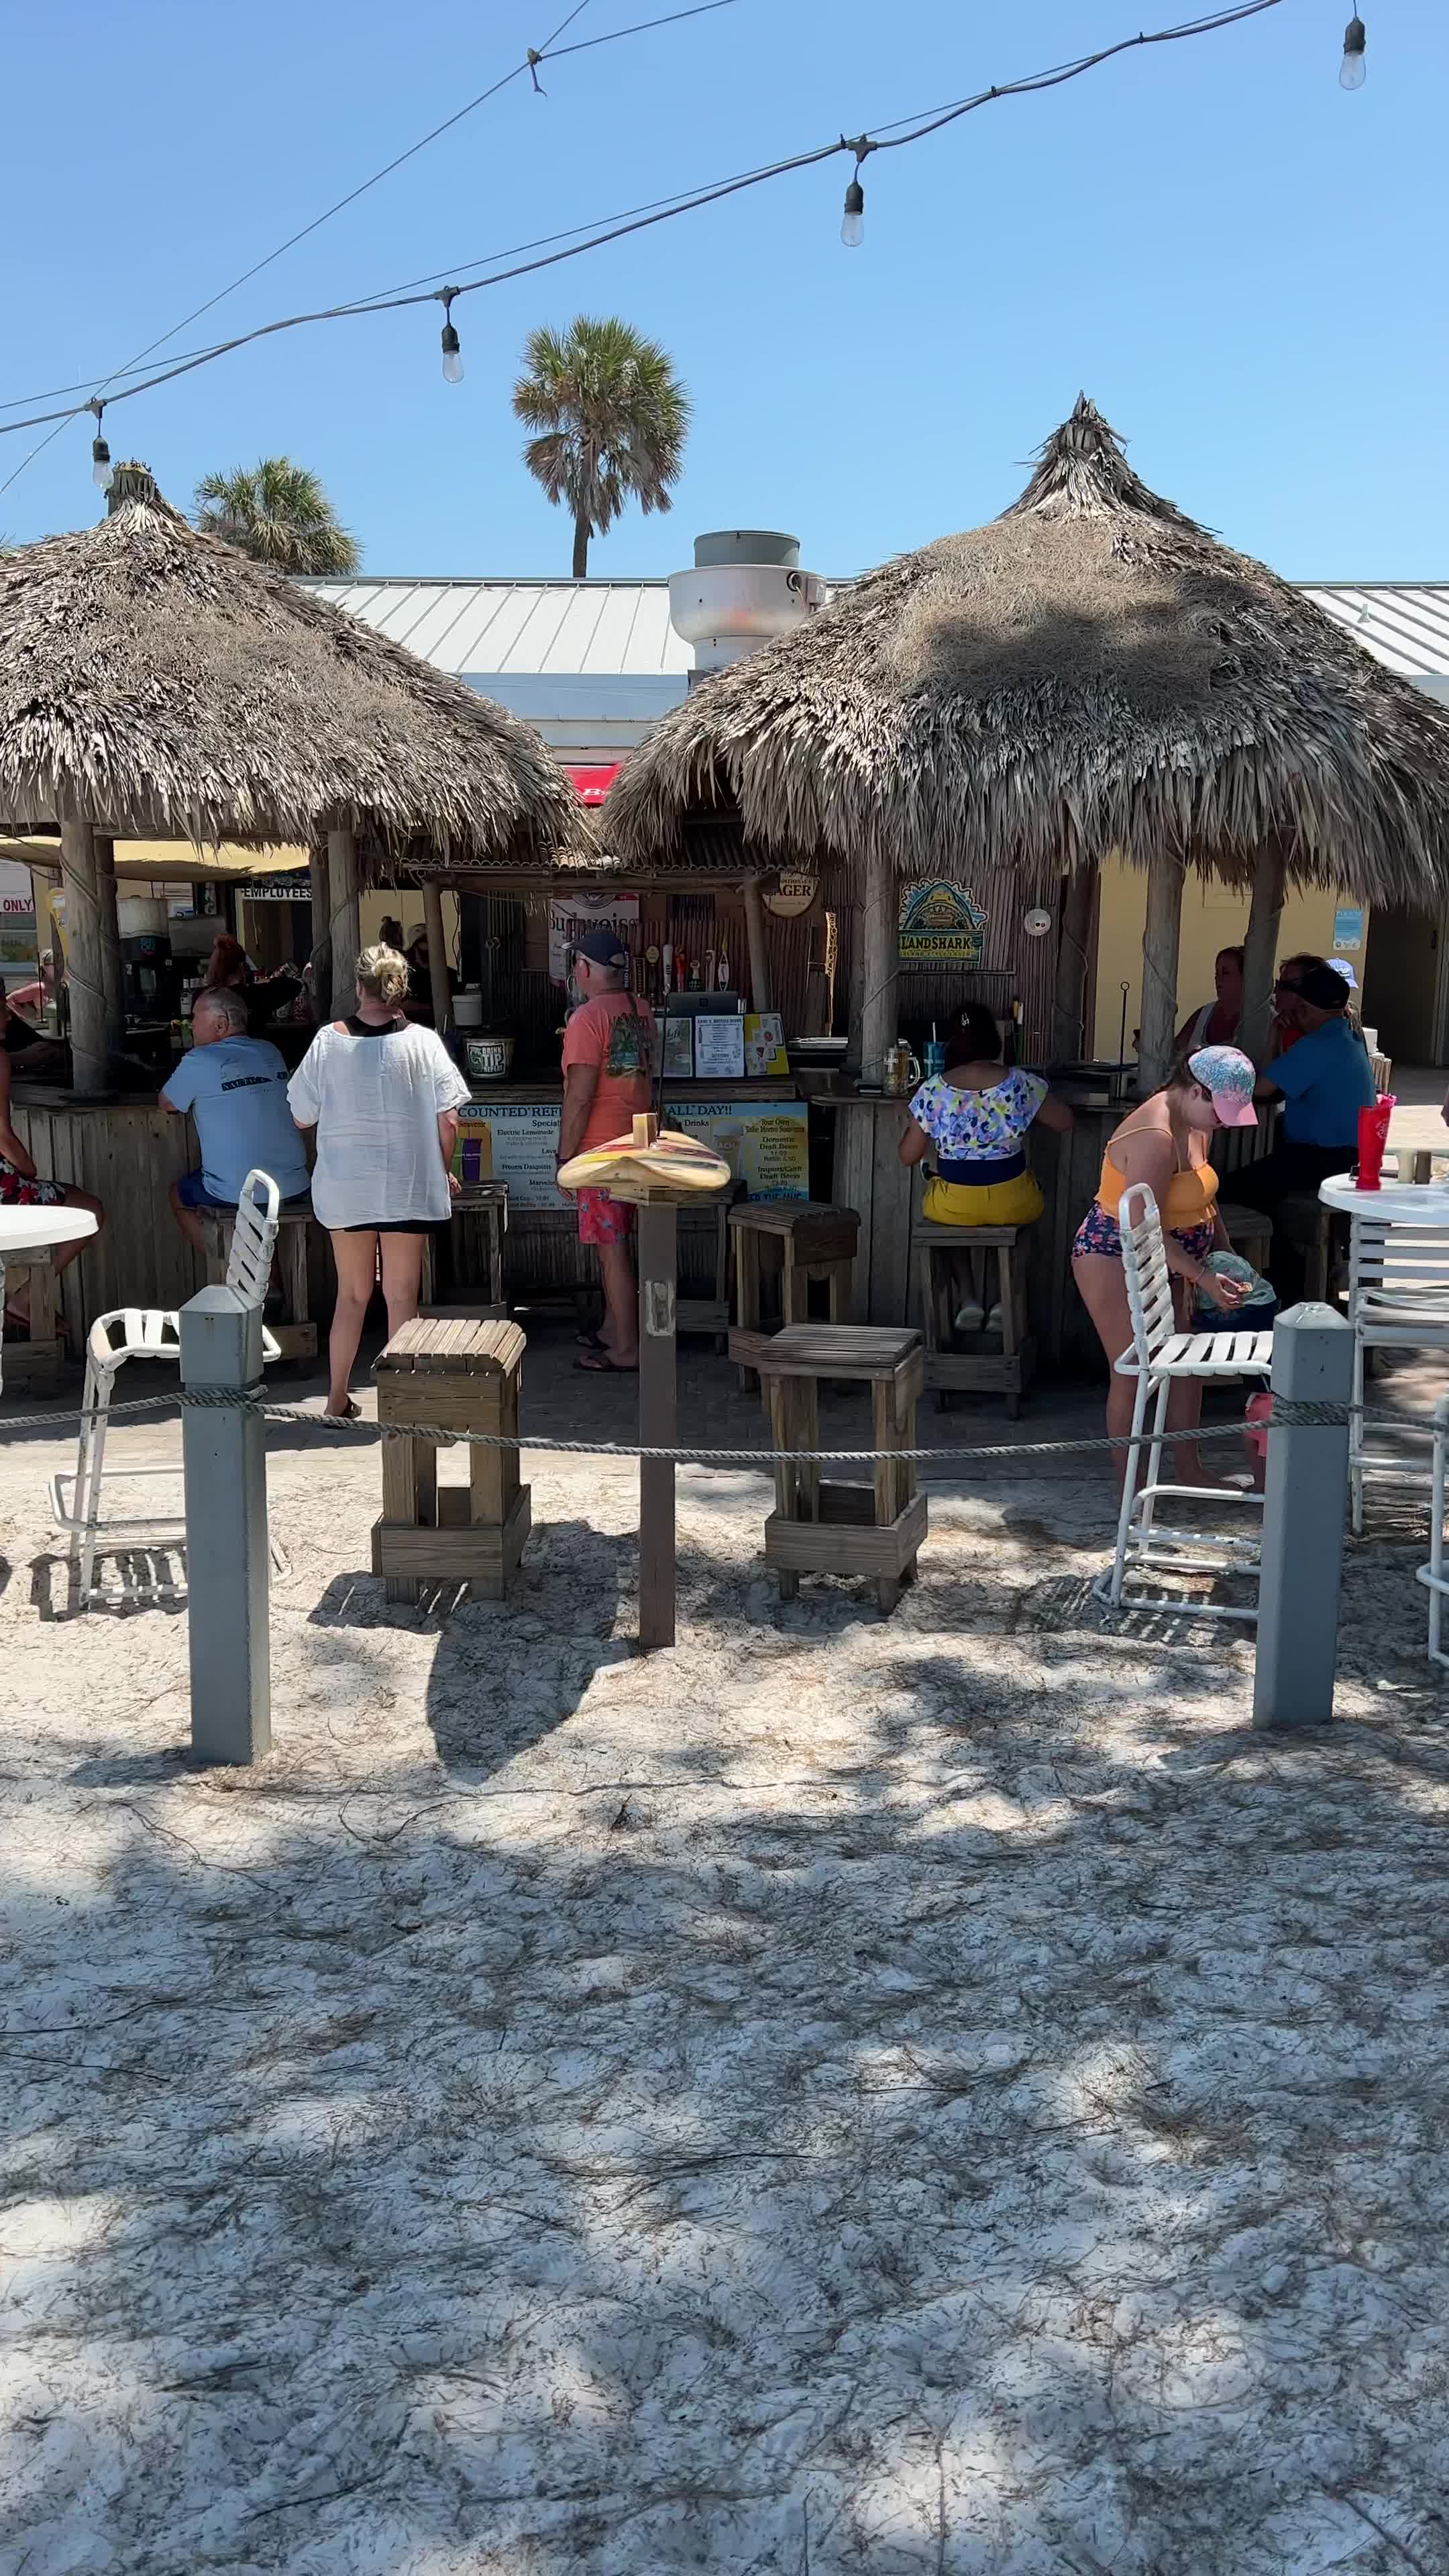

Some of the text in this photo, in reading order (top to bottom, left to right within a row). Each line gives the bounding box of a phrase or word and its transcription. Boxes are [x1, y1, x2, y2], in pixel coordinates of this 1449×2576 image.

[3, 899, 32, 912] ONLY
[901, 936, 971, 950] LANDSHARK
[482, 1054, 502, 1066] TIP
[458, 1107, 527, 1117] COUNTED
[667, 1105, 693, 1115] ALL
[698, 1105, 733, 1115] DAY!!
[684, 1118, 709, 1127] Drinks
